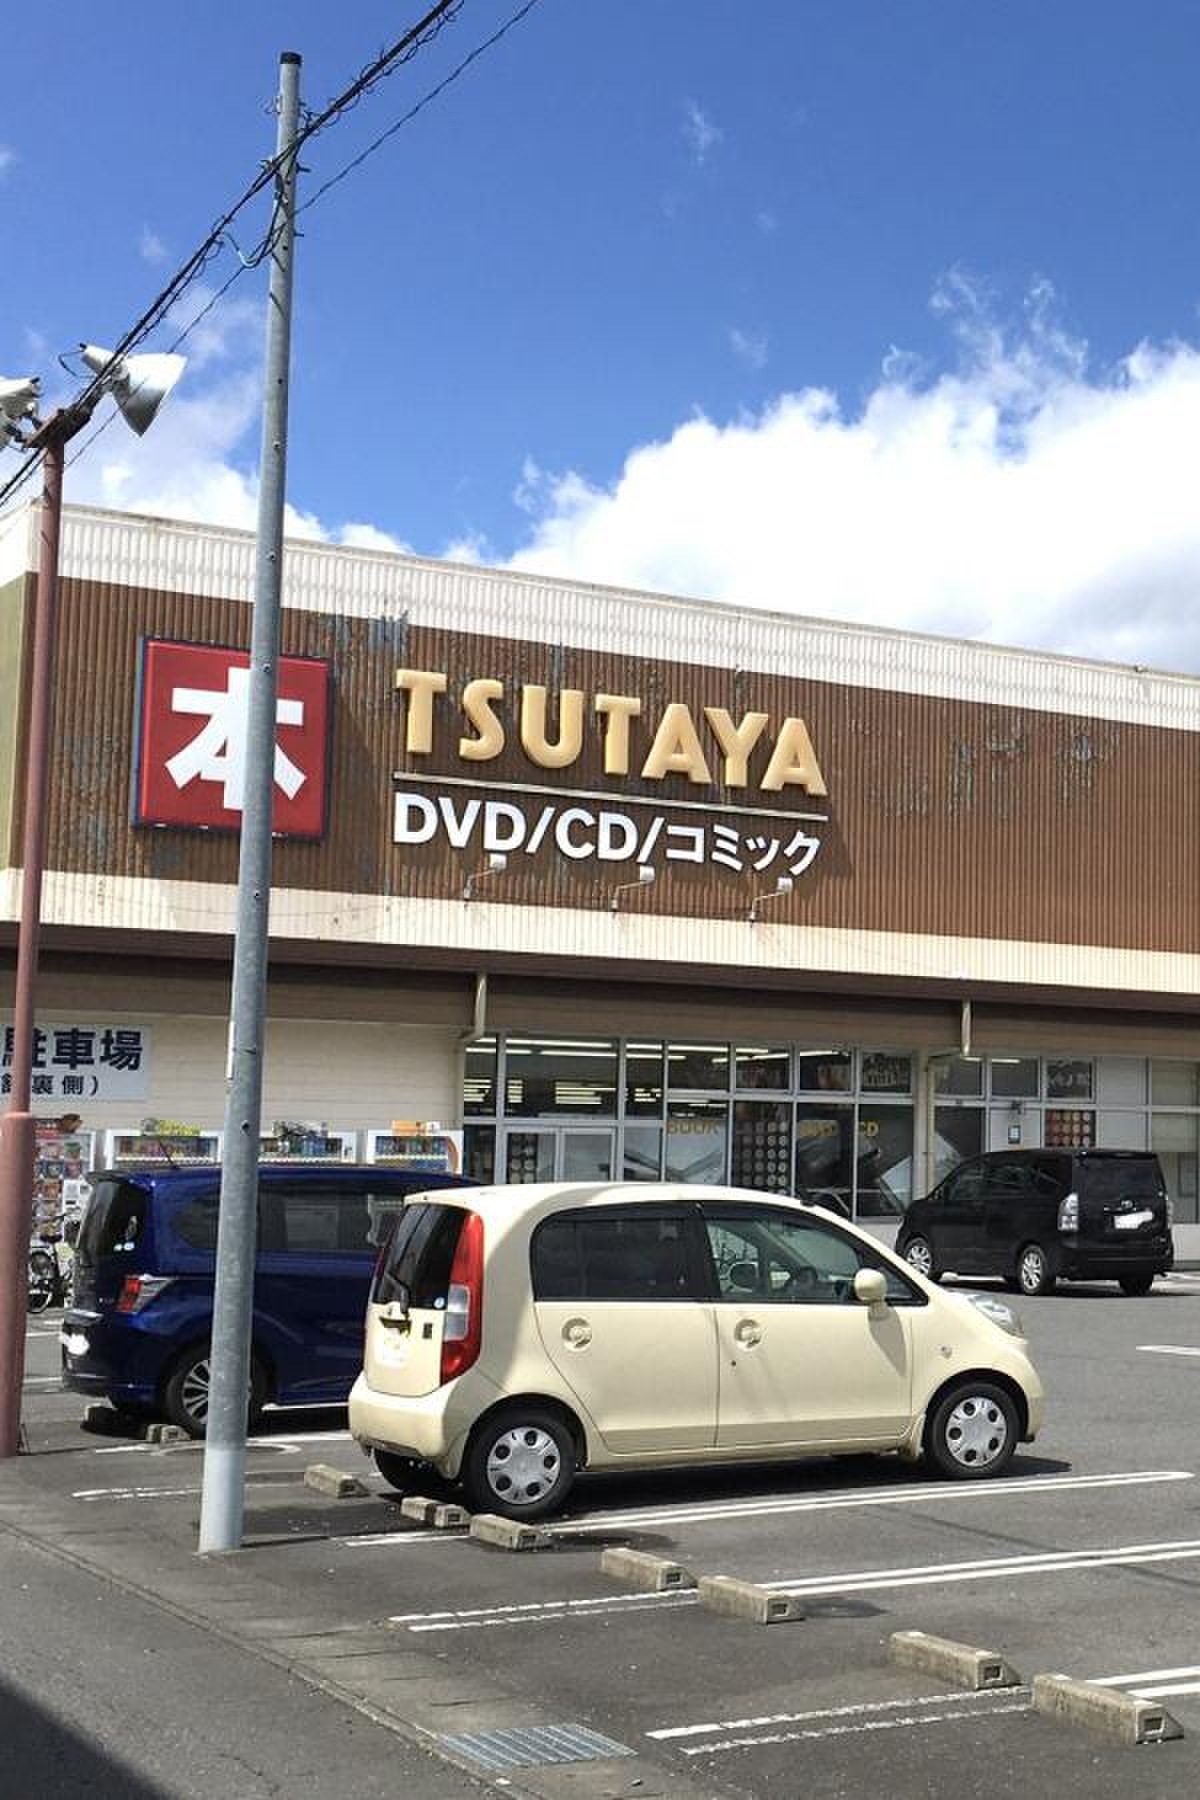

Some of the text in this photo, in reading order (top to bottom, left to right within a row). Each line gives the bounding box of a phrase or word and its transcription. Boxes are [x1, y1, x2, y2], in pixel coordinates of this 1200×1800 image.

[164, 666, 308, 811] 本
[395, 668, 828, 797] TSUTAYA
[392, 791, 821, 876] DVD/CD/コミック
